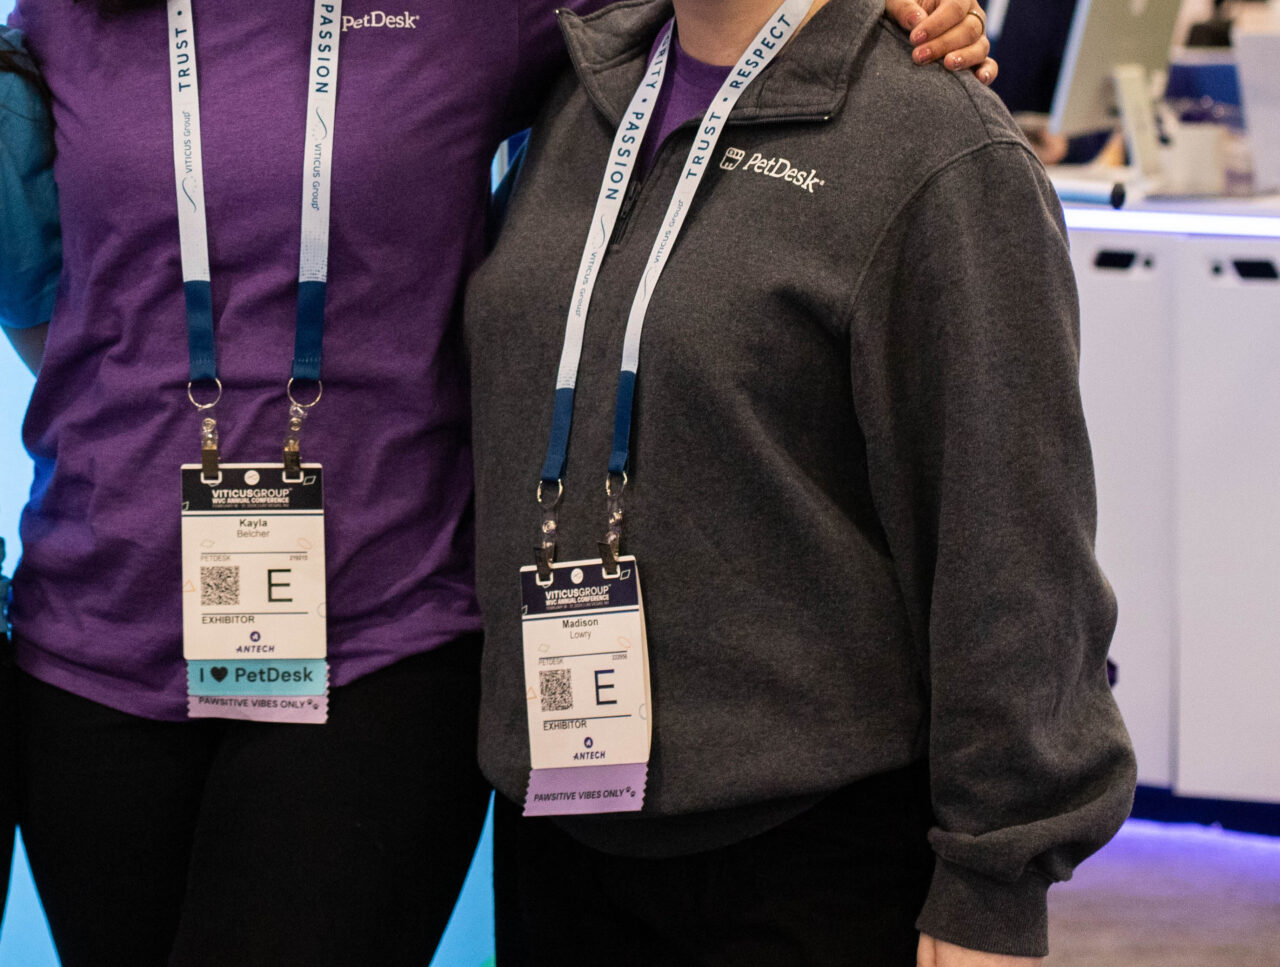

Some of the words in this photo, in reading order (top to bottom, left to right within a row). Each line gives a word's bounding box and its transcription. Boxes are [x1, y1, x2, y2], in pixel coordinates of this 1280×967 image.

[341, 10, 417, 32] PetDesk
[315, 3, 335, 94] PASSION
[175, 27, 191, 93] TRUST
[685, 111, 722, 180] TRUST
[728, 13, 792, 90] RESPECT
[183, 139, 193, 174] VITICUS
[312, 143, 322, 178] VITICUS
[605, 111, 645, 201] PASSION
[743, 153, 818, 193] PetDesk
[654, 230, 672, 264] VITICUS
[583, 252, 597, 286] VITICUS
[211, 488, 290, 498] VITICUSGROUP
[239, 518, 268, 529] Kayla
[267, 569, 293, 603] E
[545, 585, 610, 600] VITICUSGROUP
[201, 616, 255, 625] EXHIBITOR
[562, 618, 598, 628] Madison
[570, 631, 591, 640] Lowry
[236, 645, 275, 653] ANTECH
[199, 668, 204, 683] I
[235, 666, 313, 683] PetDesk
[594, 669, 617, 705] E
[198, 696, 249, 707] PAWSITIVE
[251, 699, 278, 708] VIBES
[280, 700, 305, 709] ONLY
[543, 720, 587, 731] EXHIBITOR
[573, 751, 606, 760] ANTECH
[533, 792, 576, 802] PAWSITIVE
[578, 791, 601, 800] VIBES
[602, 789, 625, 798] ONLY
